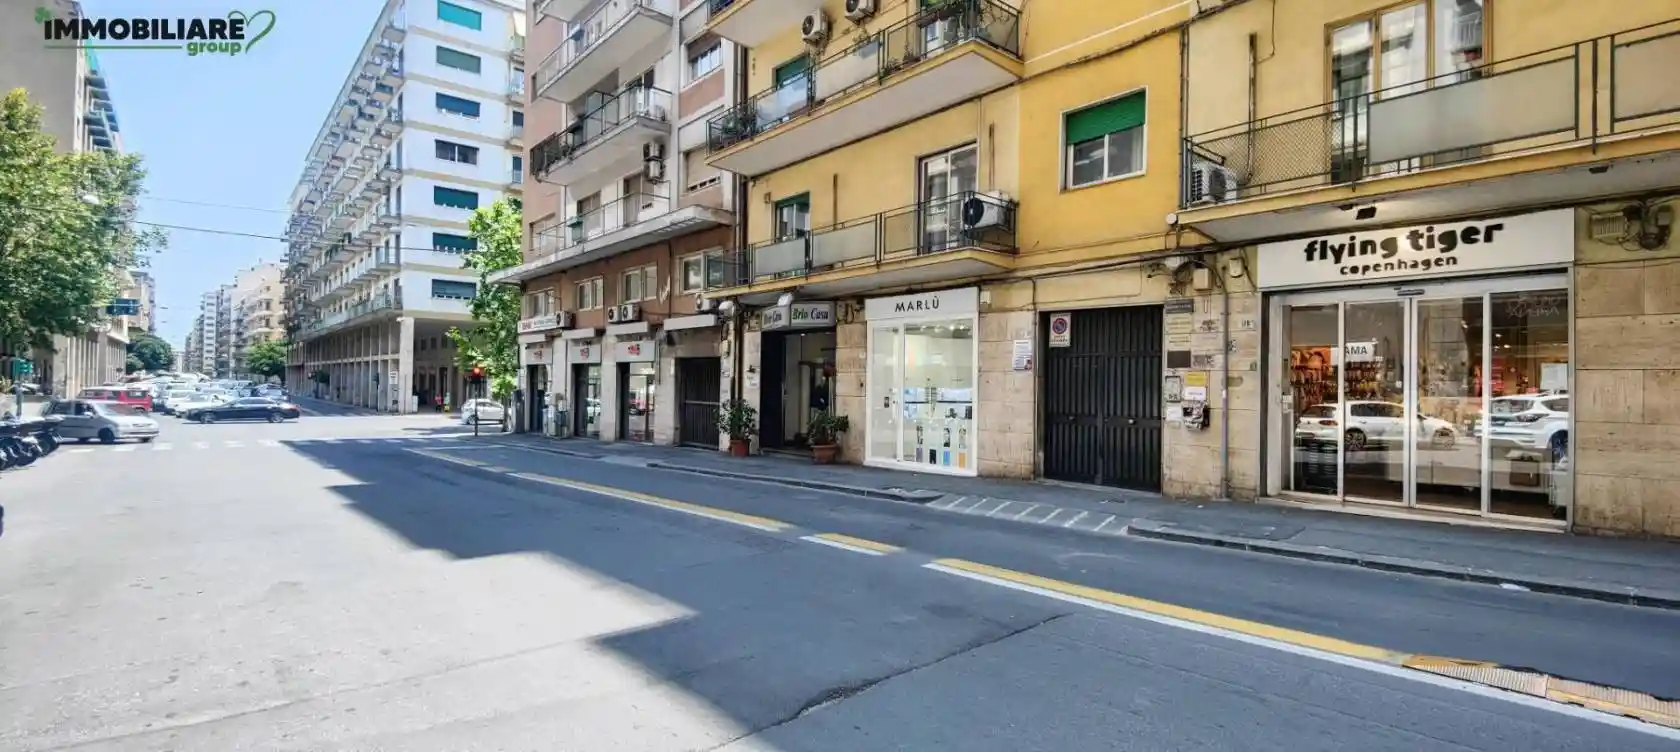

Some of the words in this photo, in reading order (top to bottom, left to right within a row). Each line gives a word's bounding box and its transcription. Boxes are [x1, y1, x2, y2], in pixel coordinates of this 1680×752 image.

[1304, 235, 1399, 264] flying
[1406, 223, 1504, 253] tiger
[1340, 255, 1458, 276] copenhagen
[792, 308, 809, 320] Brio
[810, 308, 829, 320] Casa
